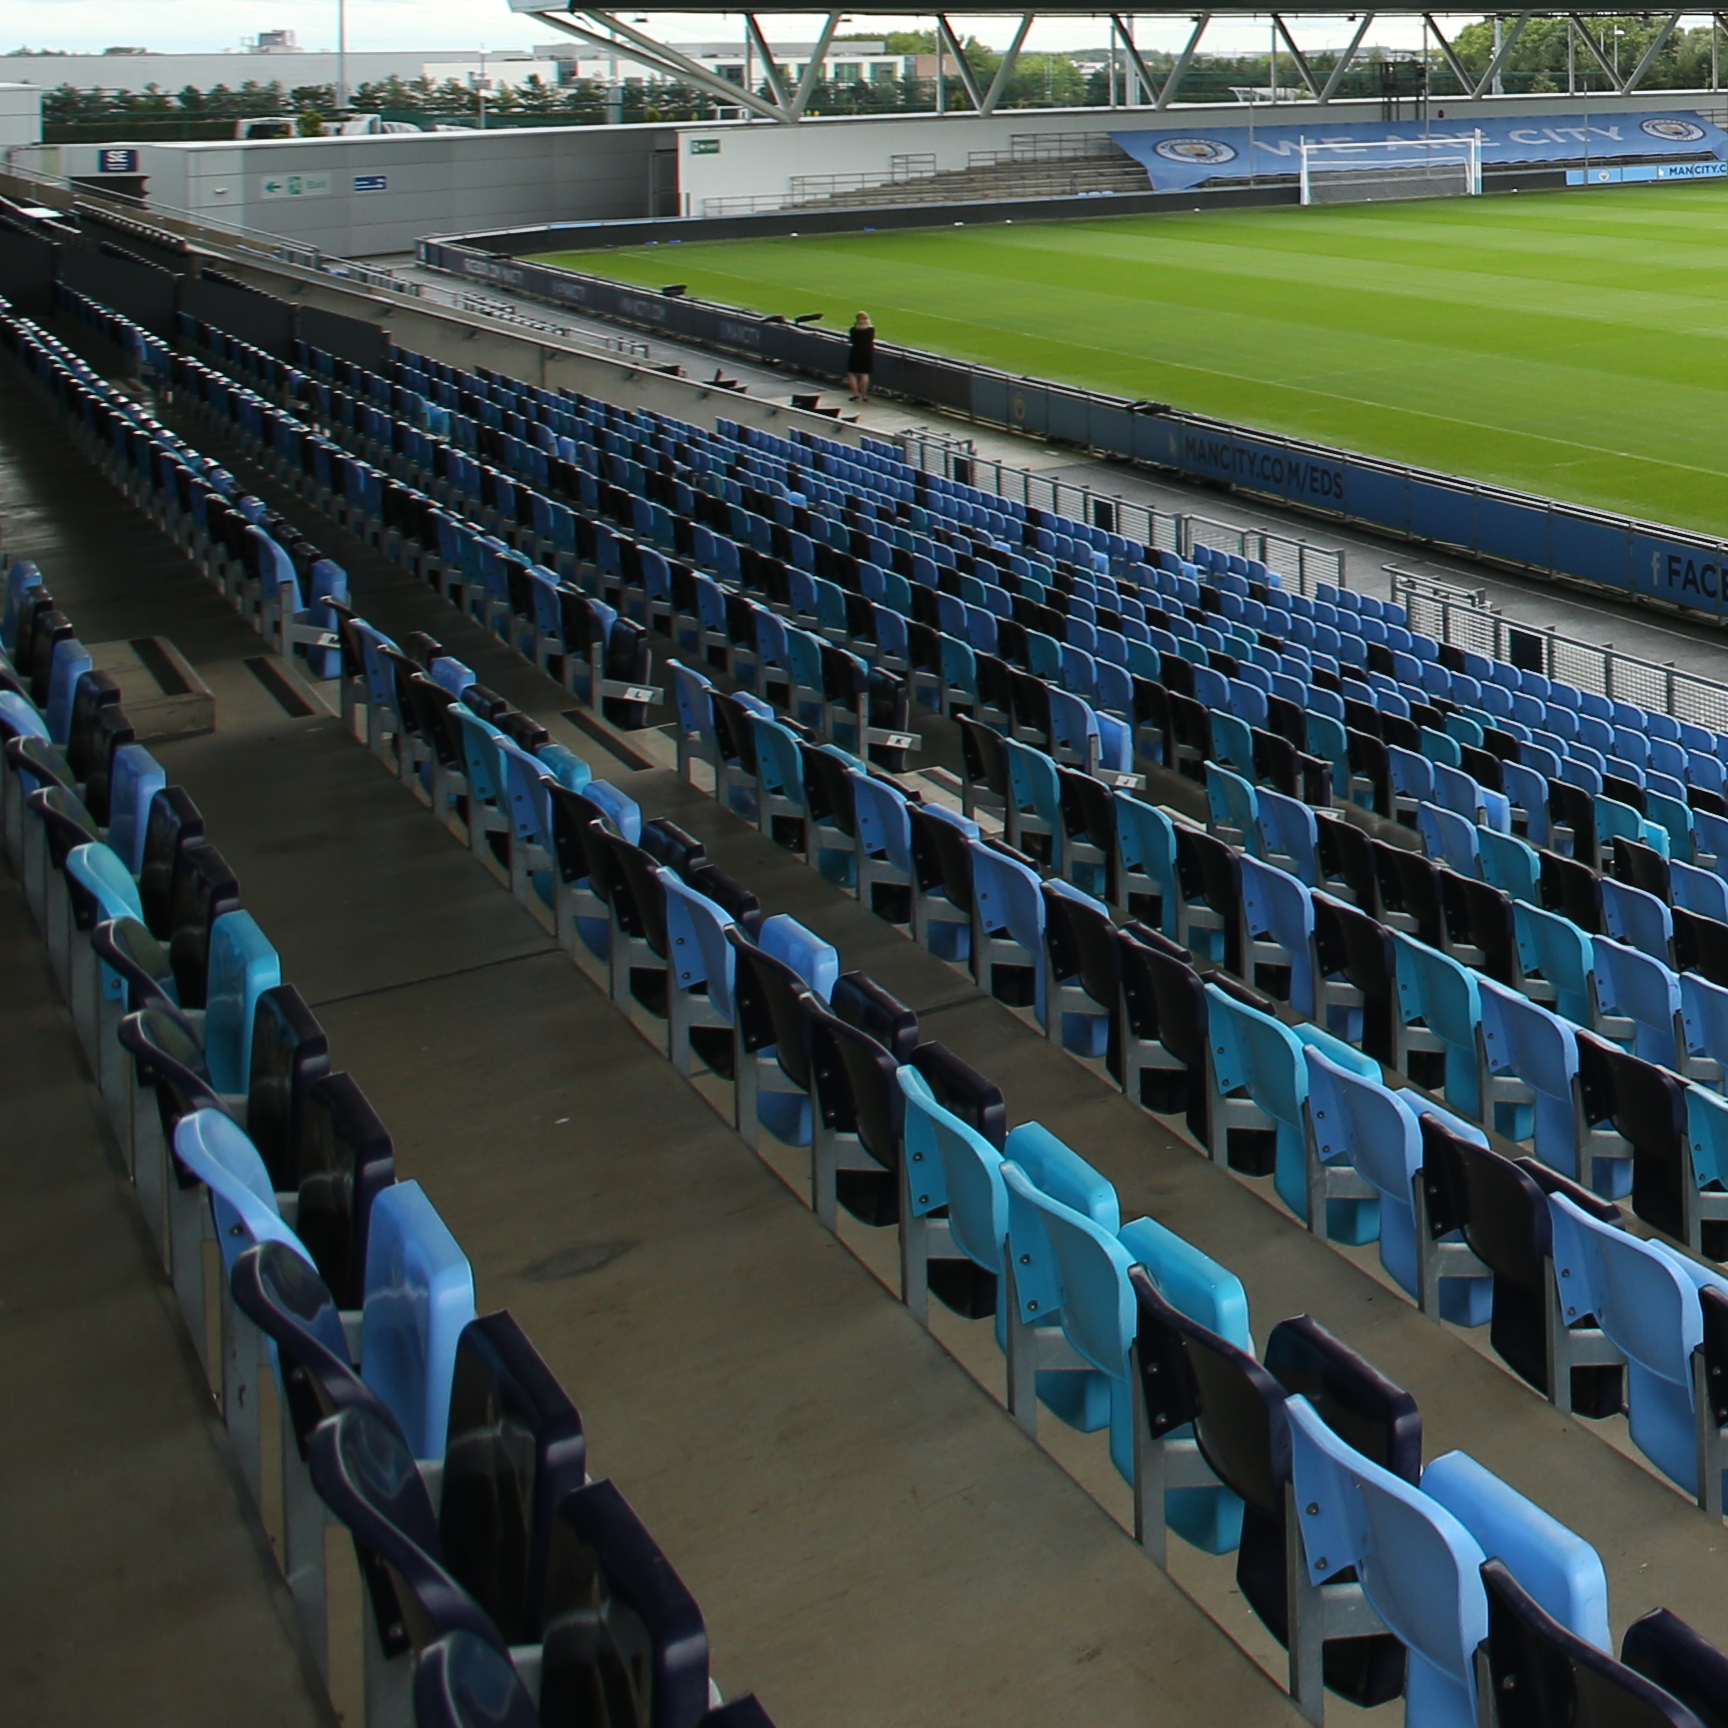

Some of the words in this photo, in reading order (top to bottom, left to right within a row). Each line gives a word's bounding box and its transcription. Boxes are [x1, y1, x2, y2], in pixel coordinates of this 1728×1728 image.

[106, 150, 129, 162] SE
[1252, 136, 1367, 156] WE
[1387, 131, 1500, 150] ARE
[1509, 126, 1623, 145] CITY
[1184, 436, 1344, 500] MANCITY.COM/EDS
